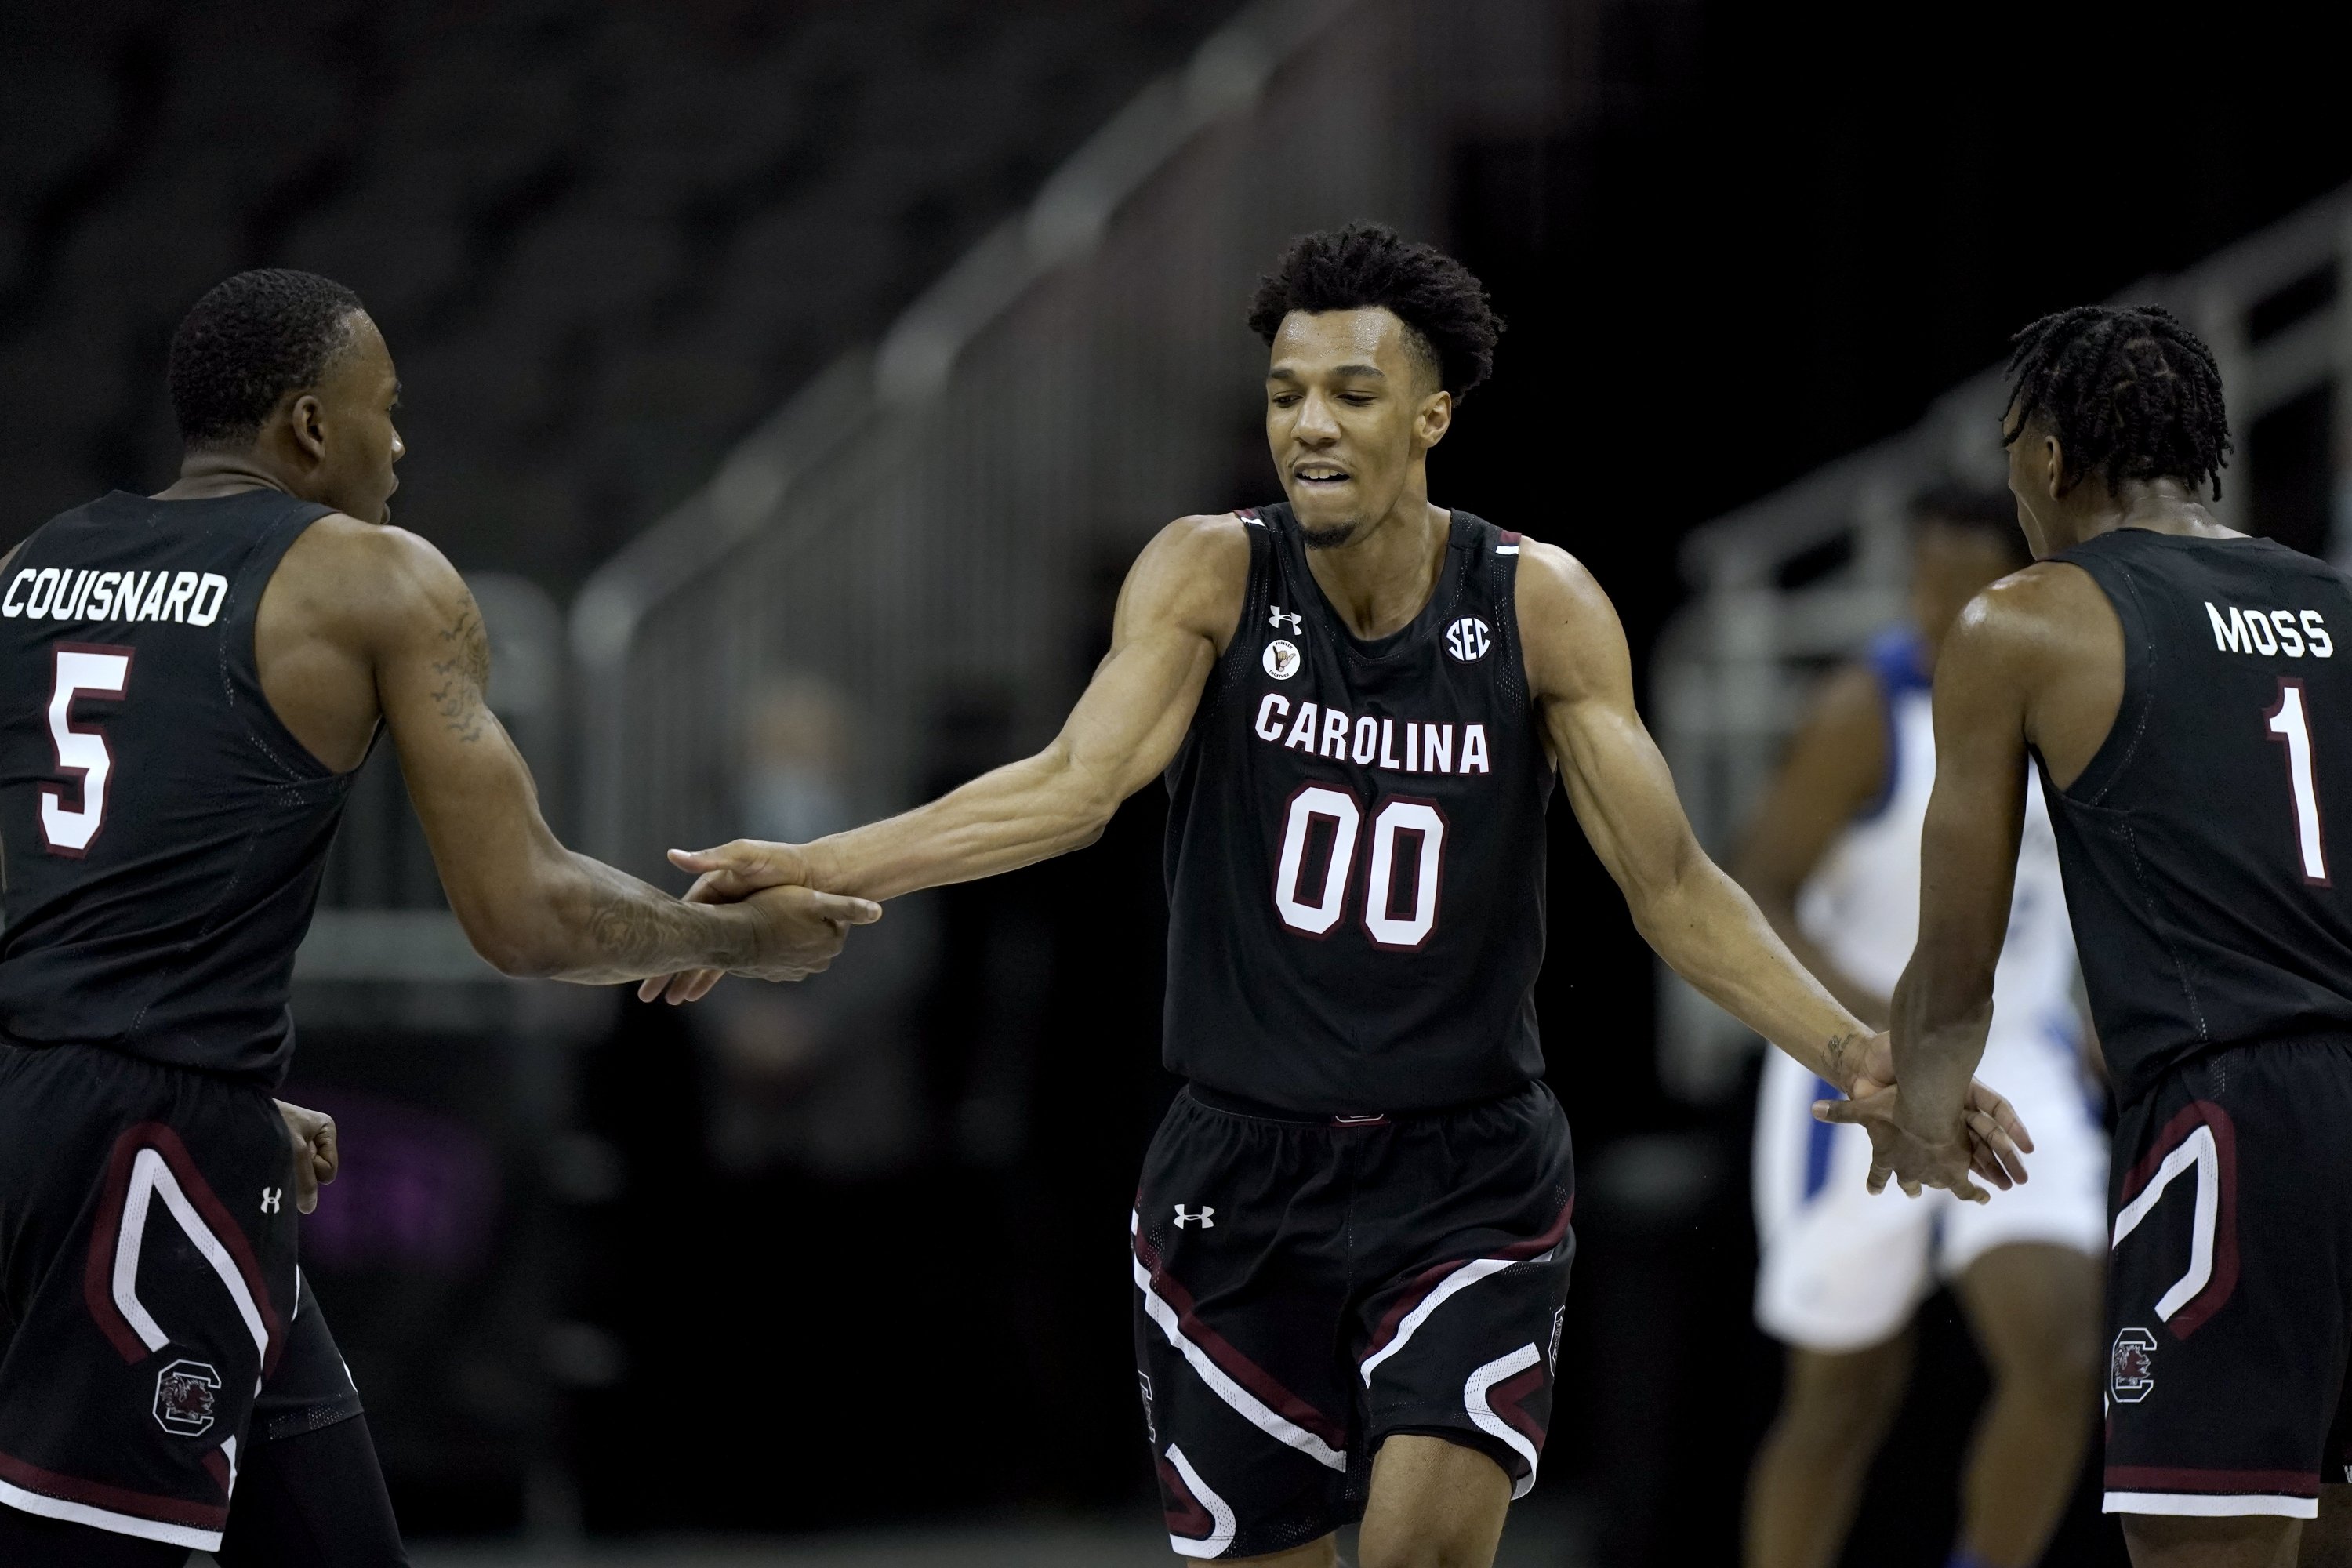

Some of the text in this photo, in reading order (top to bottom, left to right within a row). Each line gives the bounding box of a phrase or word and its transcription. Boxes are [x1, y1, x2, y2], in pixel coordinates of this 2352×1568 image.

[2, 568, 228, 626] COUISNARD
[2205, 601, 2333, 657] MOSS
[1269, 670, 1290, 678] TOGETHER
[1446, 618, 1490, 661] SEC
[40, 648, 131, 852] 5
[1254, 692, 1490, 774] CAROLINA
[2267, 682, 2328, 883] 1
[1273, 785, 1446, 949] 00
